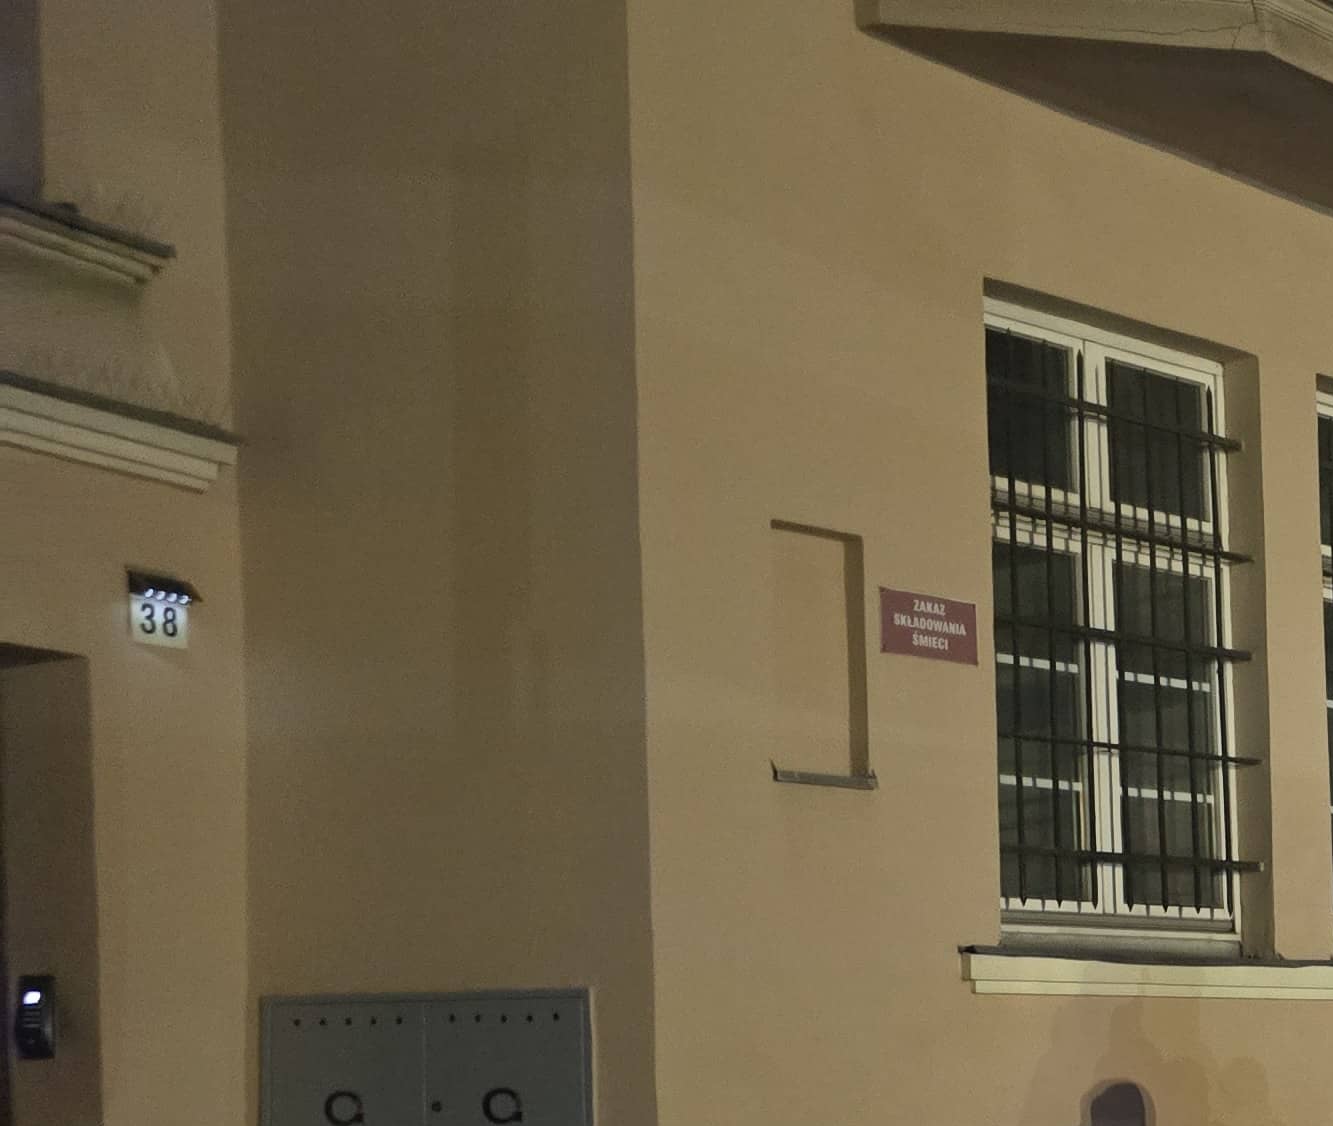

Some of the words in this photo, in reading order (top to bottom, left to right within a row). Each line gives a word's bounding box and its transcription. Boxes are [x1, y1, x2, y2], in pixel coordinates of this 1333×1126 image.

[912, 599, 946, 616] ZAKAZ
[141, 603, 178, 637] 38
[893, 613, 967, 636] SKŁADOWANIA
[912, 630, 949, 650] ŚMIECI
